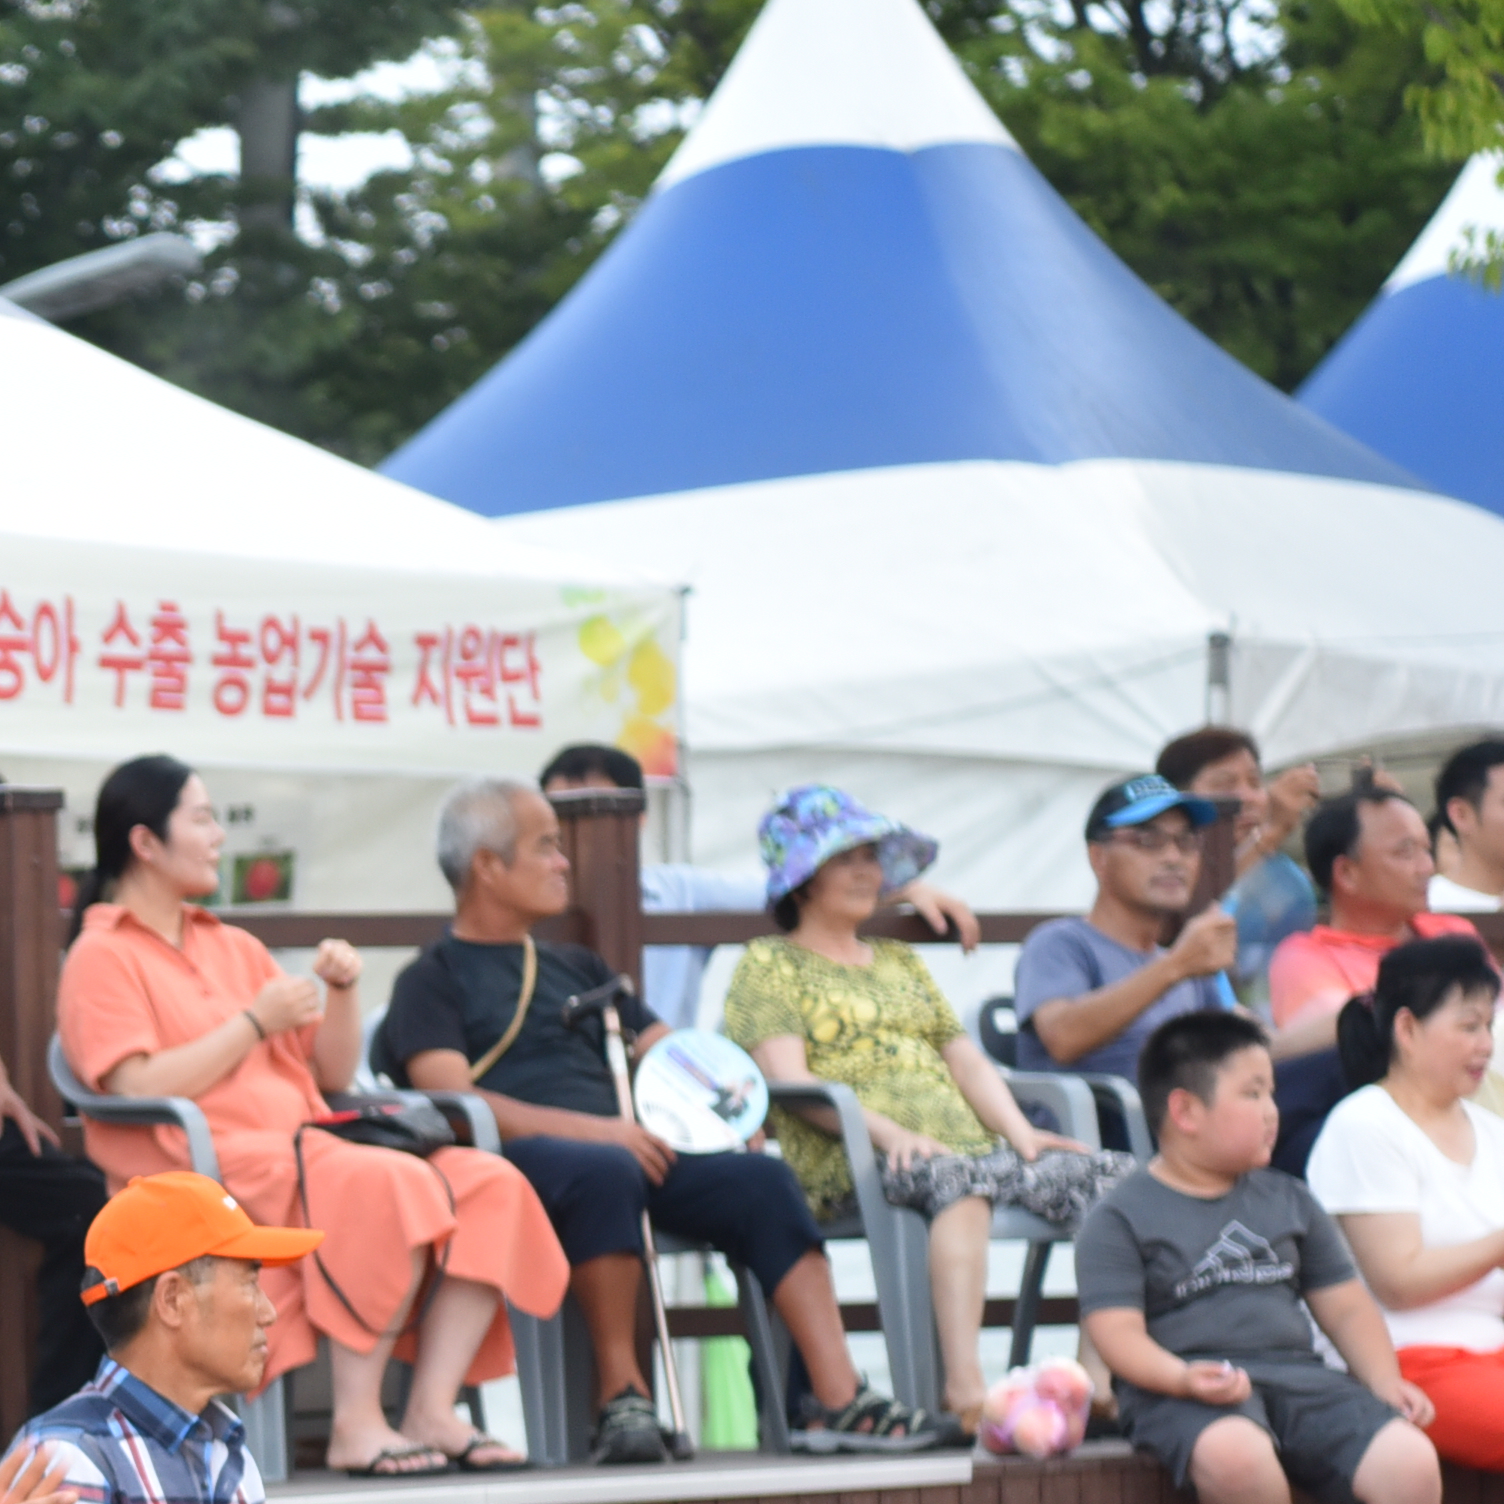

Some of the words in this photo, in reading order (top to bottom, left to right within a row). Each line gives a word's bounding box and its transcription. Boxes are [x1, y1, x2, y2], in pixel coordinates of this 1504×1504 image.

[98, 600, 192, 710] 수출
[211, 609, 390, 722] 농업기술
[412, 624, 542, 728] 지원단
